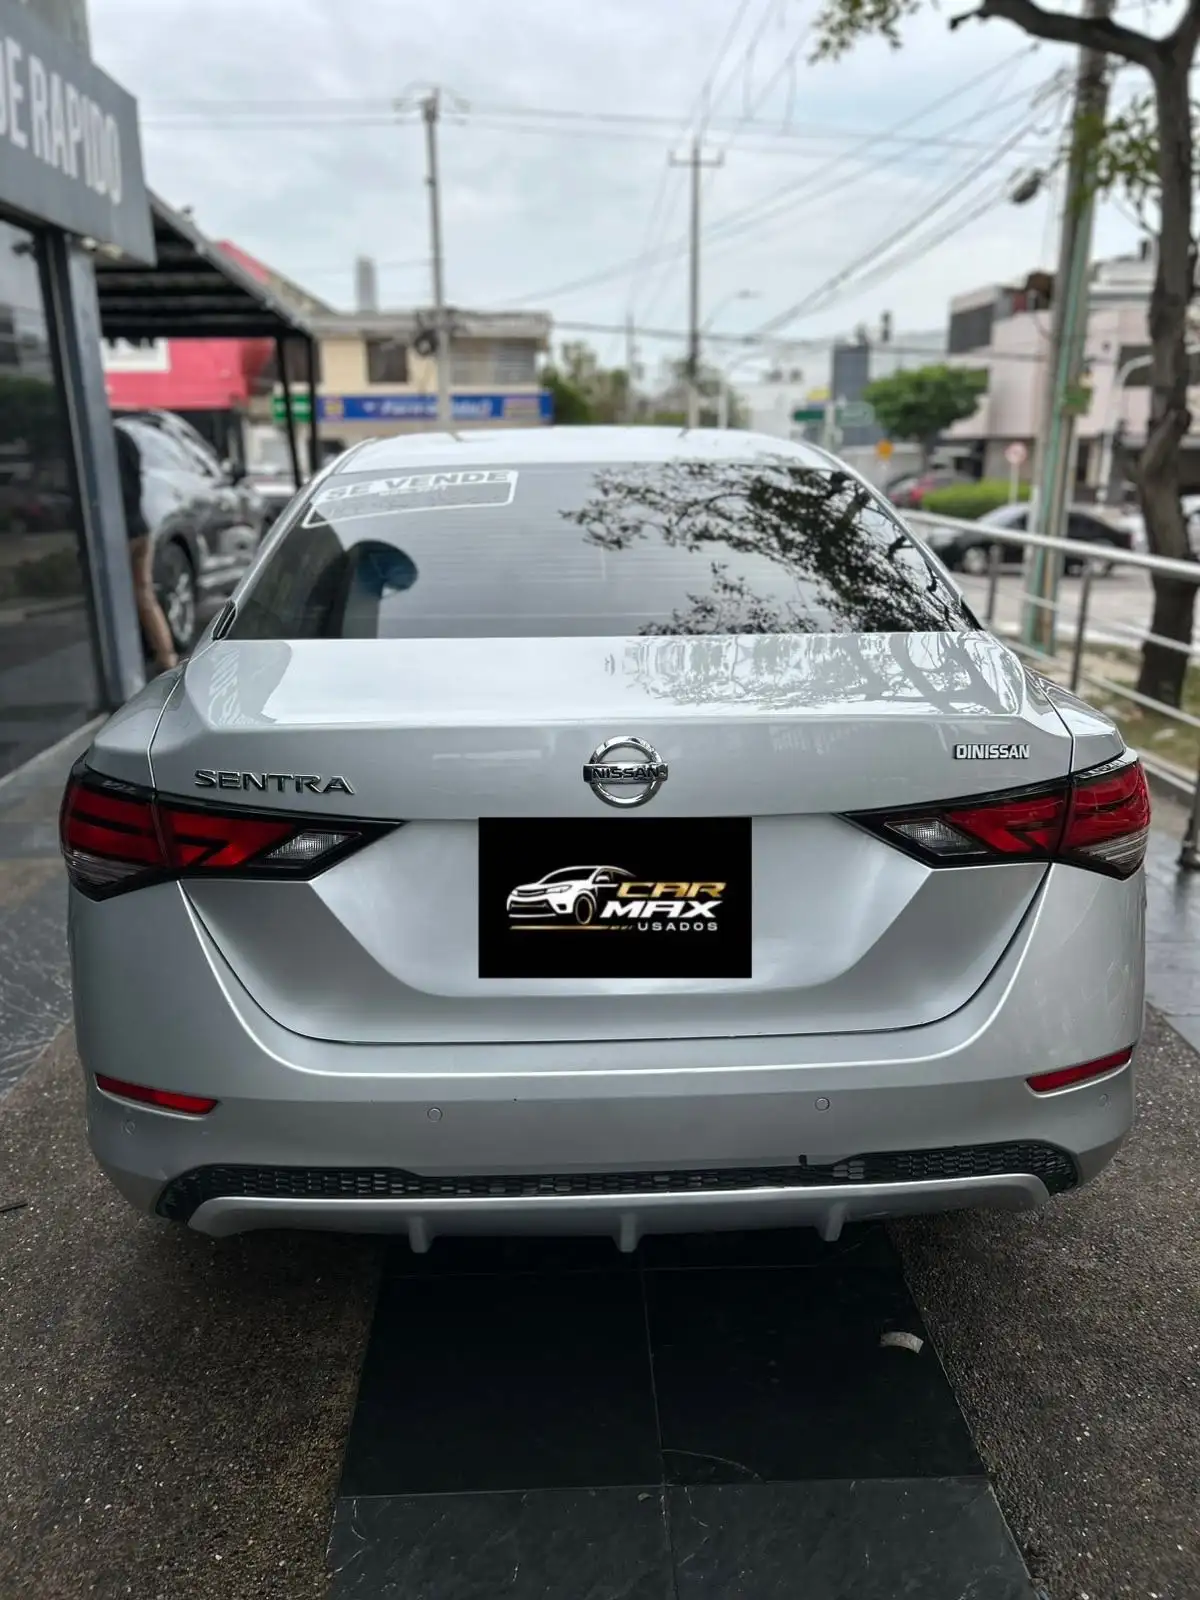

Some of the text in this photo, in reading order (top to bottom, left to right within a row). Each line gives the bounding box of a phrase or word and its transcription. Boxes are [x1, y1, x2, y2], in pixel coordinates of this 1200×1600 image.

[29, 53, 122, 206] RAPIDO
[385, 471, 510, 489] VENDE
[194, 769, 355, 795] SENTRA
[592, 767, 659, 779] NISSAN
